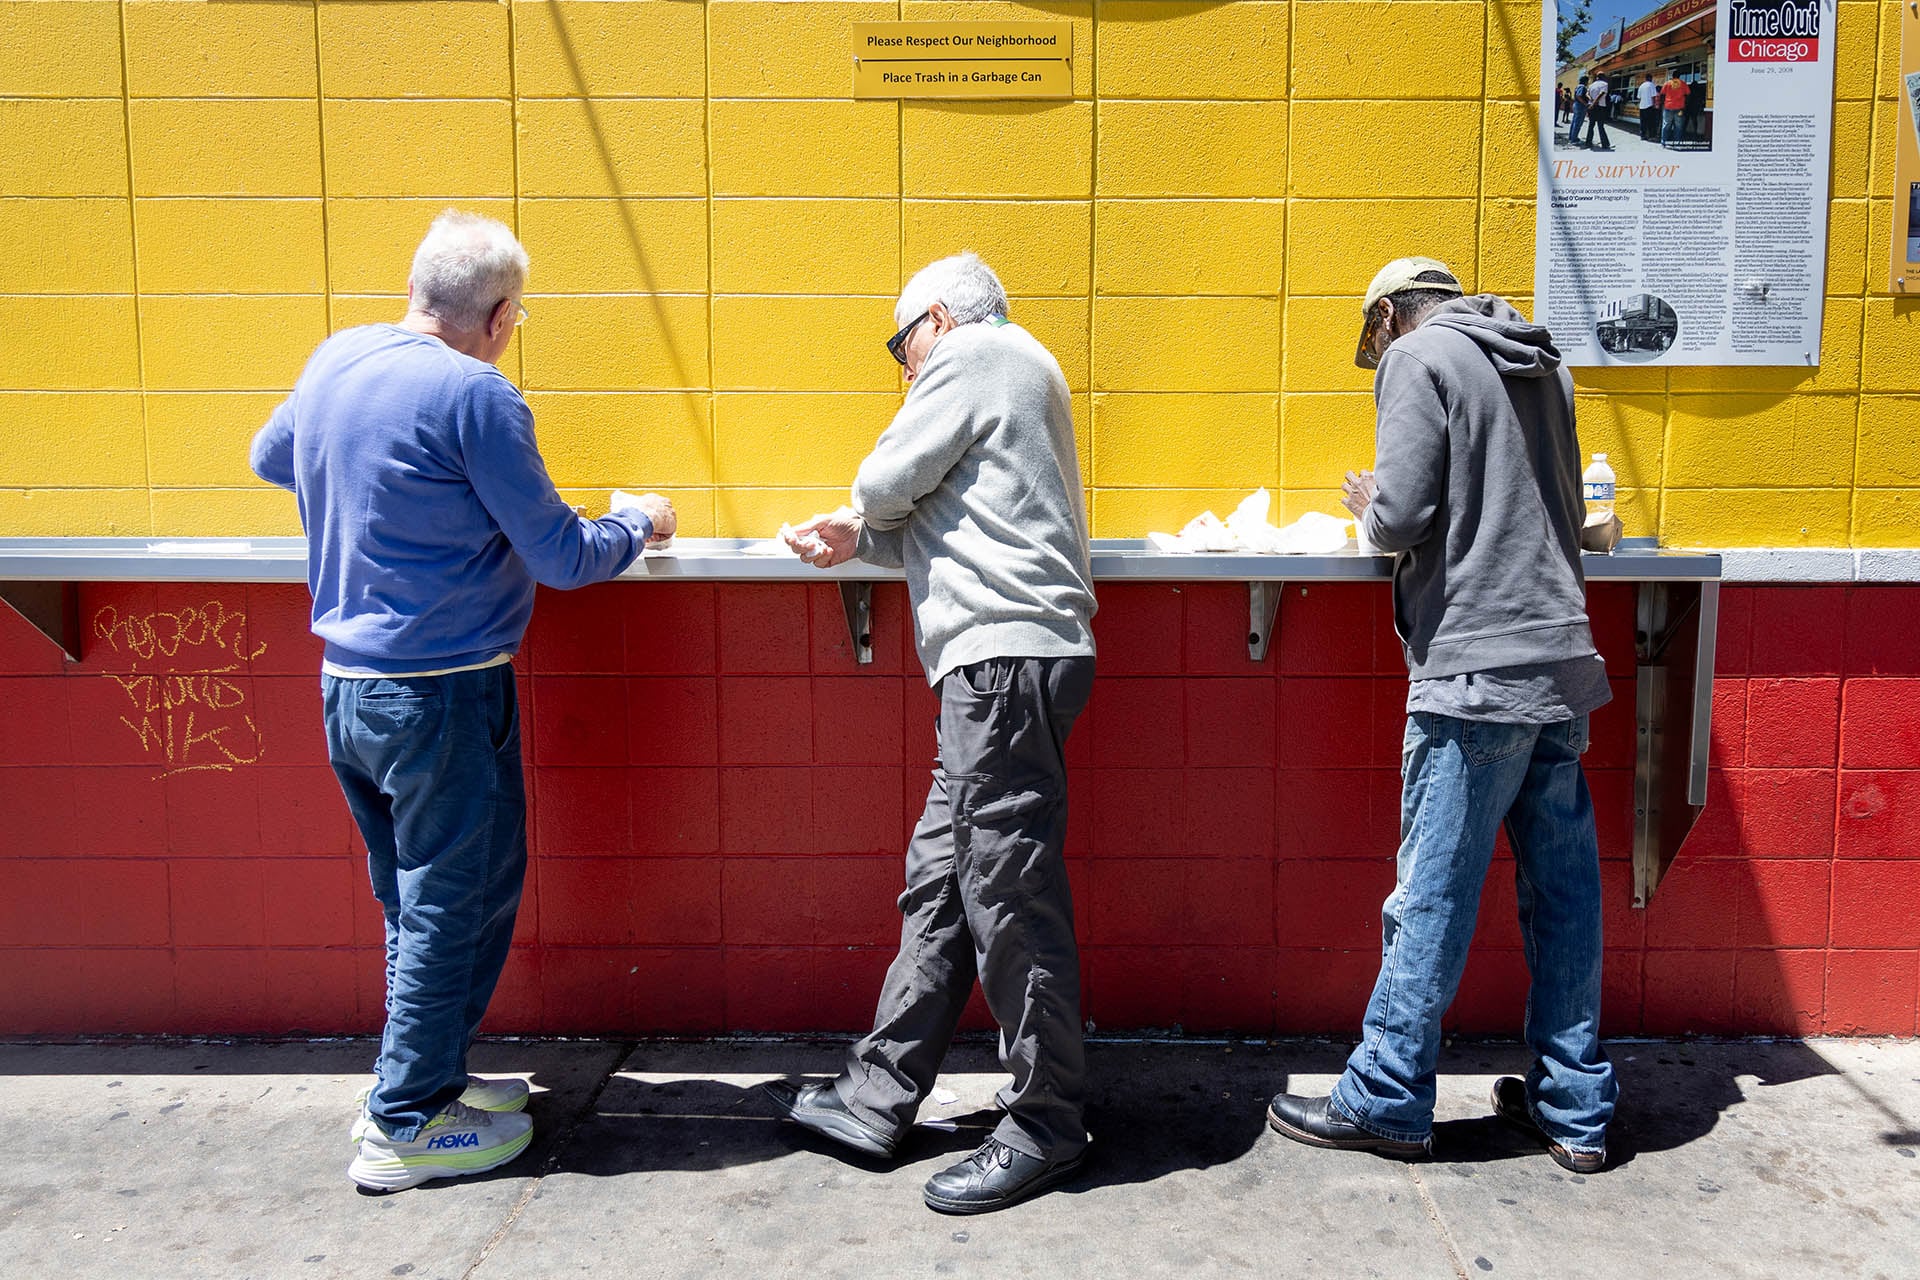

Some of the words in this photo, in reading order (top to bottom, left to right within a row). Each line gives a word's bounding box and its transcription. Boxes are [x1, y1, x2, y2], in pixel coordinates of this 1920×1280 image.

[1732, 1, 1778, 36] Time
[1781, 1, 1818, 36] Out
[1630, 19, 1659, 37] POLISH
[867, 36, 902, 46] Please
[906, 36, 949, 47] Respect
[952, 36, 973, 46] Our
[976, 35, 1056, 47] Neighborhood
[1738, 40, 1808, 61] Chicago
[883, 73, 912, 82] Place
[915, 72, 945, 82] Trash
[949, 72, 959, 82] in
[971, 72, 1017, 84] Garbage
[1021, 72, 1041, 82] Can
[1552, 160, 1590, 178] The
[1595, 160, 1680, 178] survivor
[427, 1132, 479, 1149] HOKA
